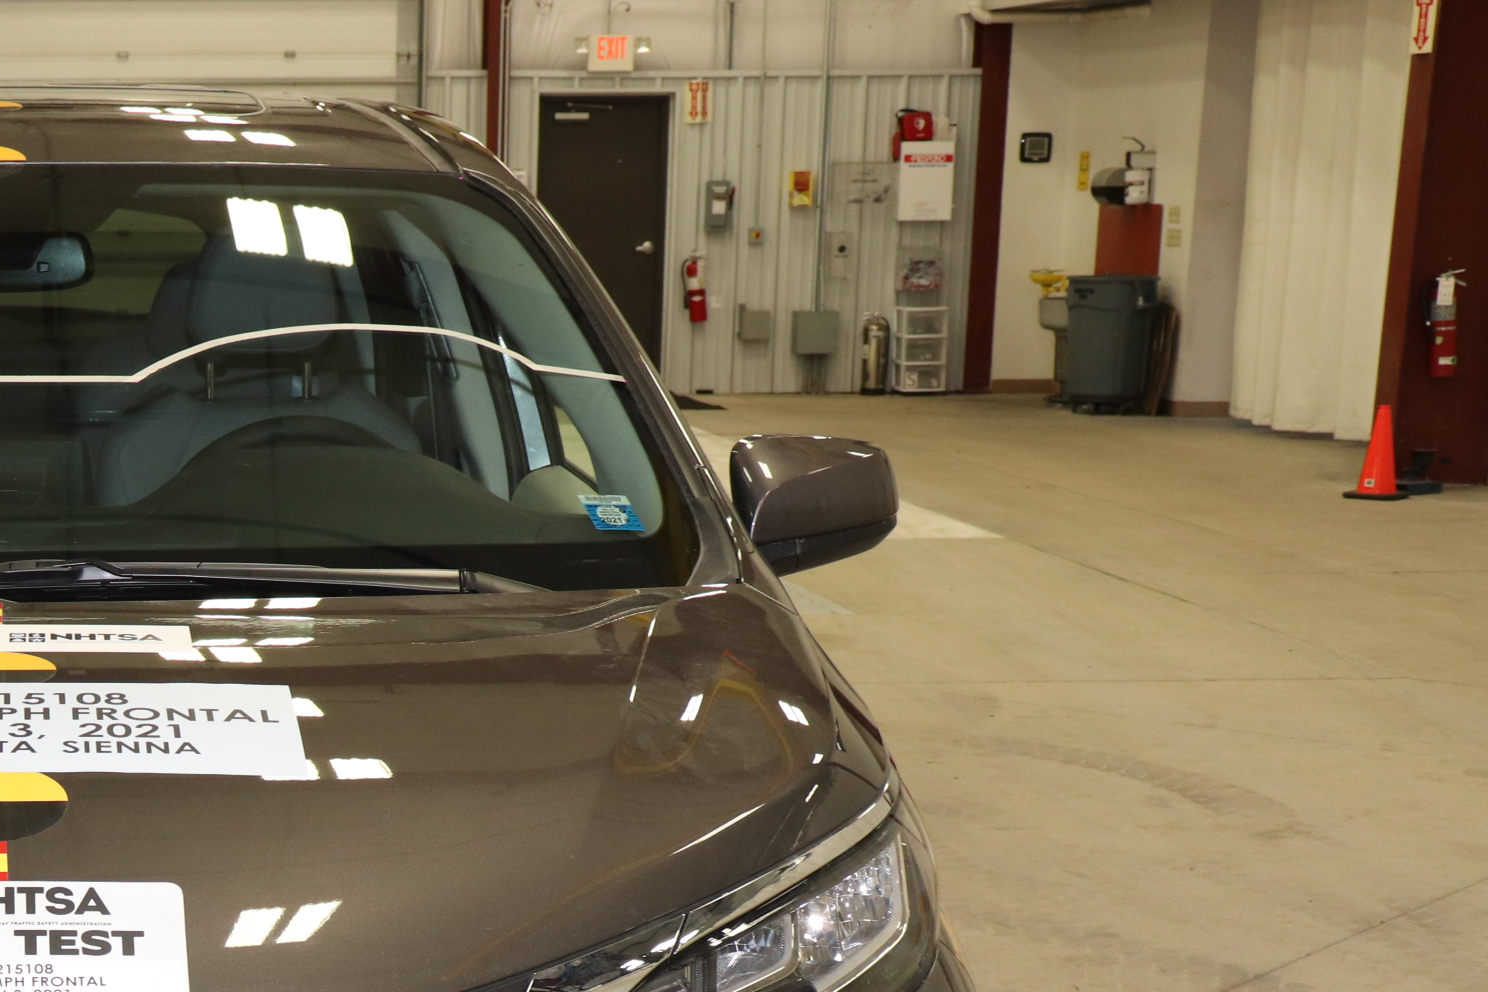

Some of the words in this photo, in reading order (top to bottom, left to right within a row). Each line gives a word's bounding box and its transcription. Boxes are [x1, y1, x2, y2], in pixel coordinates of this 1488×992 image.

[597, 35, 628, 60] EXIT
[50, 633, 164, 641] NHTSA
[71, 707, 280, 723] FRONTAL
[8, 723, 46, 740] 3,
[78, 723, 182, 739] 2021
[62, 740, 202, 755] SIENNA
[13, 929, 145, 956] TEST
[32, 976, 106, 987] FRONTAL
